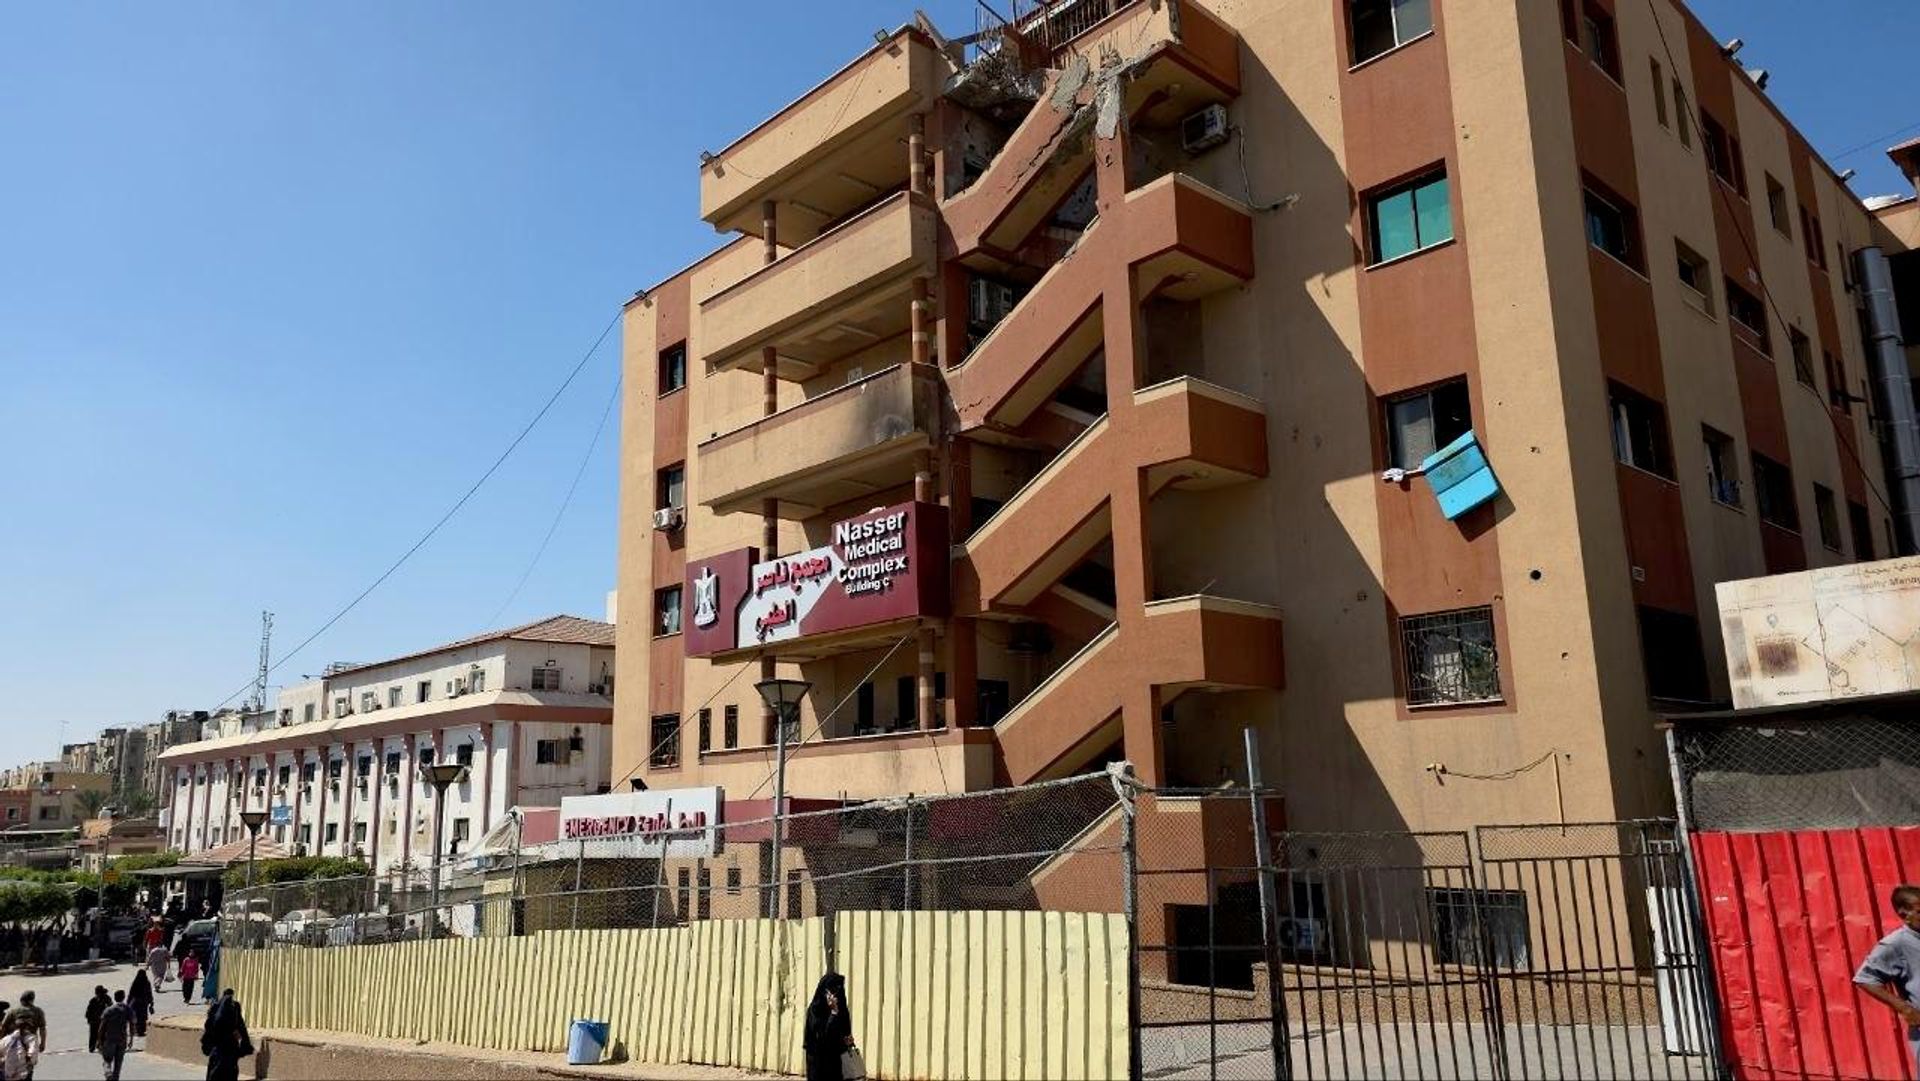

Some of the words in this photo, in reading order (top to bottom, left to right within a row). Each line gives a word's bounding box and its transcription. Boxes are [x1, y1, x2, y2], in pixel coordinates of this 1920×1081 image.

[836, 511, 904, 545] Nasser
[844, 533, 902, 560] Medical
[757, 561, 788, 598] ناصر
[790, 557, 830, 595] مجمع
[837, 556, 906, 582] Complex
[845, 579, 881, 594] Building
[882, 577, 890, 587] C
[756, 599, 795, 641] الطبي
[565, 814, 634, 838] EMERGENCY
